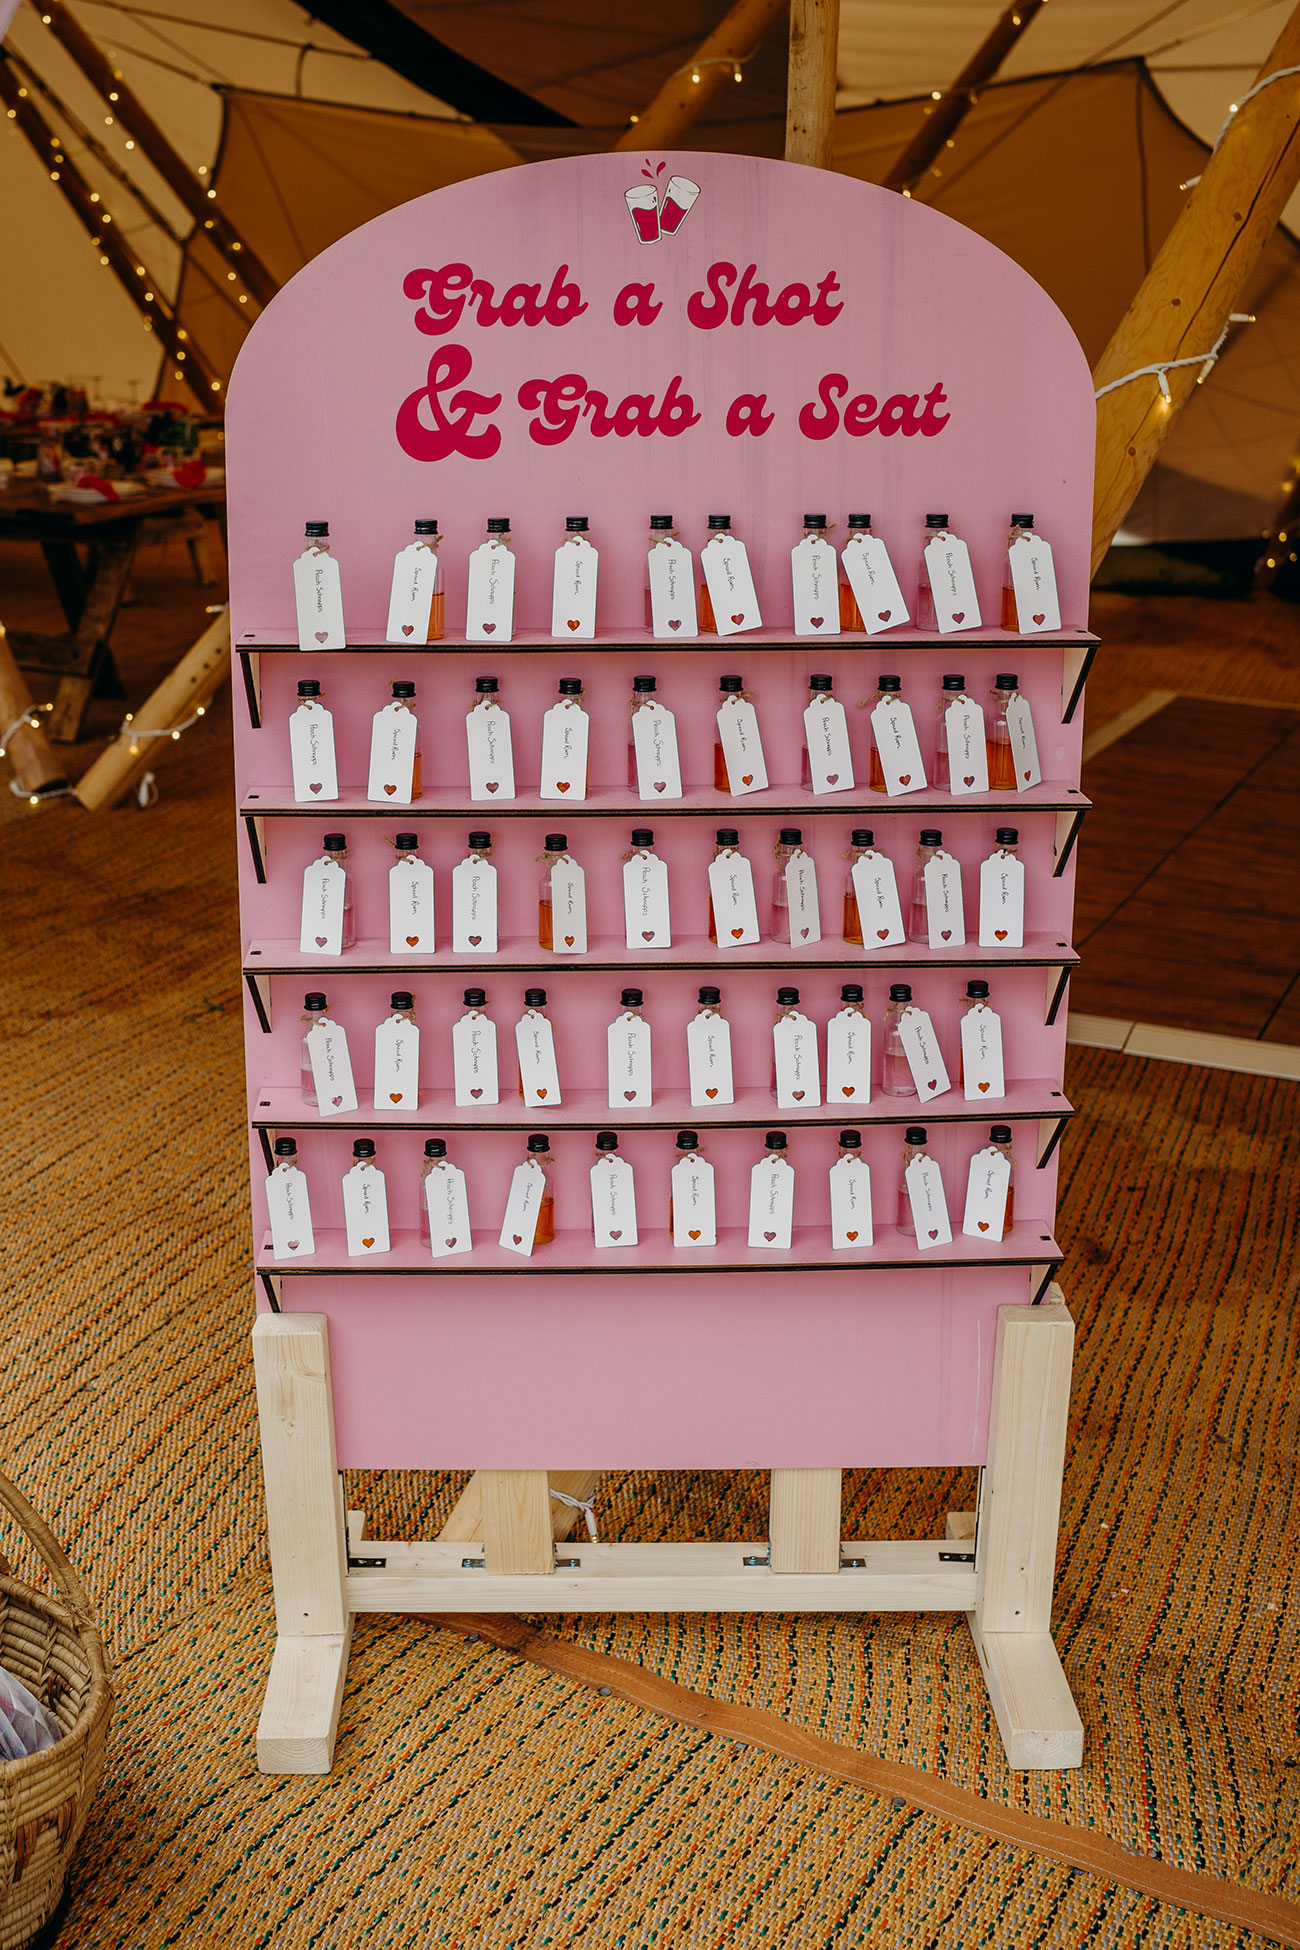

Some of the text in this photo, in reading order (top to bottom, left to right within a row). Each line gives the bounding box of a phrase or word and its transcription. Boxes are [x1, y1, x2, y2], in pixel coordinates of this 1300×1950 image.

[403, 262, 844, 335] Grab a Shot
[396, 344, 950, 462] & Grab a Seat
[727, 575, 736, 592] Rum
[867, 570, 876, 586] Rum
[1033, 575, 1042, 591] Rum
[410, 586, 420, 602] Rum
[573, 579, 582, 596] Rum
[739, 736, 748, 752] Rum
[894, 734, 902, 750] Rum
[390, 745, 400, 761] Rum
[562, 744, 573, 760] Rum
[731, 892, 740, 907] Rum
[876, 895, 886, 909] Rum
[1000, 891, 1010, 905] Rum
[410, 900, 421, 916] Rum
[708, 1053, 716, 1068] Rum
[846, 1050, 856, 1064] Rum
[979, 1045, 989, 1061] Rum
[394, 1057, 404, 1073] Rum
[690, 1192, 700, 1207] Rum
[984, 1186, 993, 1200] Rum
[362, 1200, 372, 1214] Rum
[849, 1195, 857, 1210] Rum
